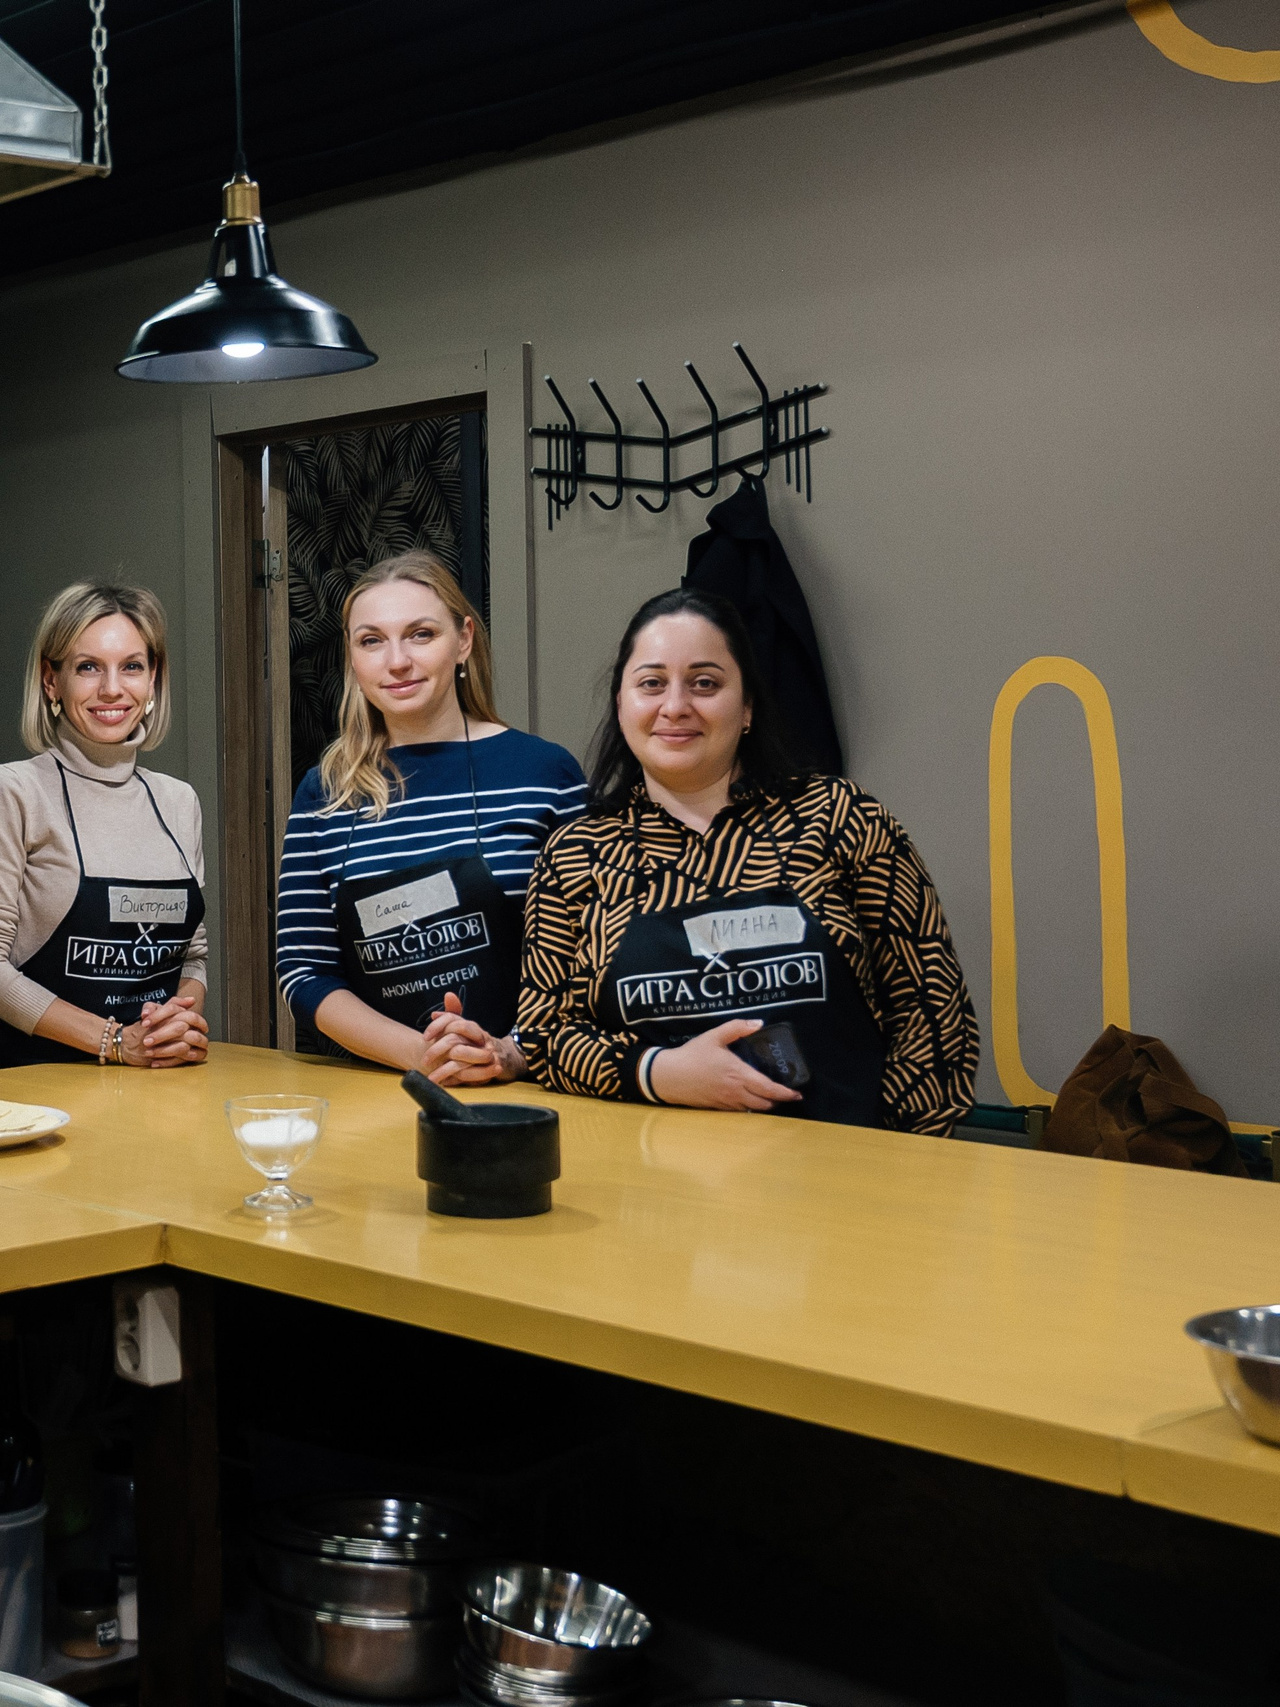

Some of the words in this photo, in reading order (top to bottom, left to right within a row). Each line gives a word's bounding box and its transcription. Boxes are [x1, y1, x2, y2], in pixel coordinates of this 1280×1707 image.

[120, 895, 179, 918] Виктория
[357, 940, 400, 962] ИГРА
[401, 919, 481, 953] СТОЛОВ
[72, 942, 128, 966] ИГРА
[93, 967, 147, 976] КУЛИНАРНА
[382, 979, 430, 998] АНОХИН
[431, 964, 479, 988] СЕРГЕЙ
[624, 978, 695, 1006] ИГРА
[700, 959, 819, 998] СТОЛОВ
[653, 999, 733, 1014] КУЛИНАРНАЯ
[738, 990, 787, 1005] СТУДИЯ
